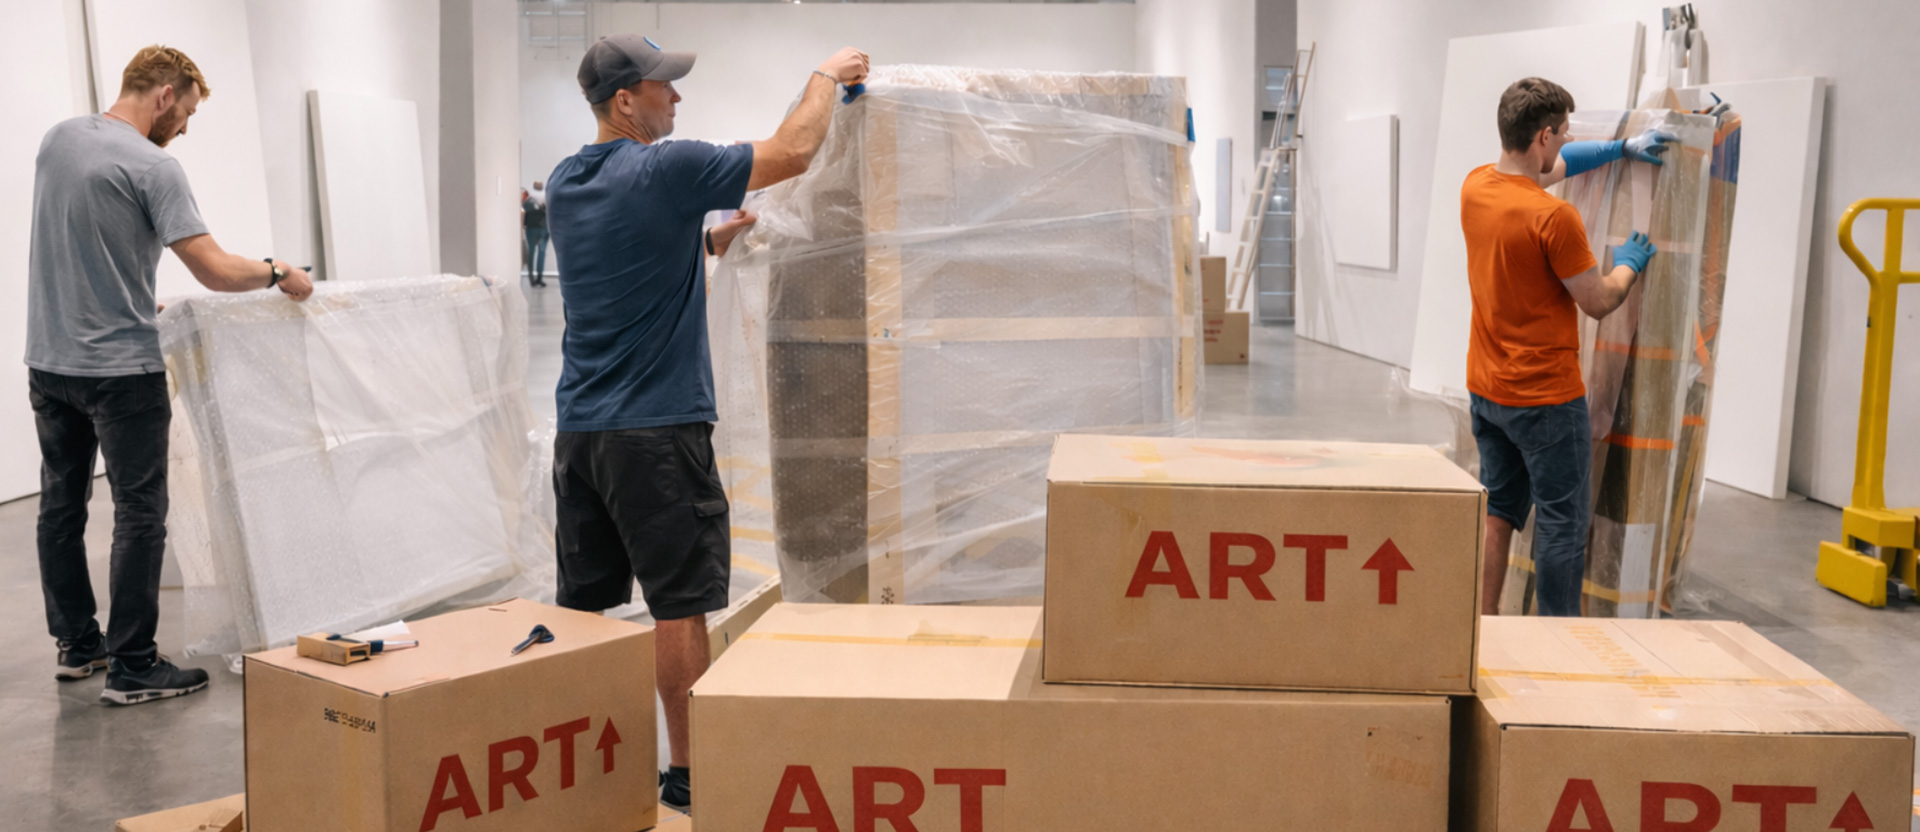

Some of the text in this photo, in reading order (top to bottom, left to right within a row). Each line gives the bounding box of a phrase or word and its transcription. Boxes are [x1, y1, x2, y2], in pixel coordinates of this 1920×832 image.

[1125, 530, 1350, 602] ART
[419, 717, 590, 832] ART
[763, 765, 1007, 832] ART
[1546, 778, 1817, 832] ART
